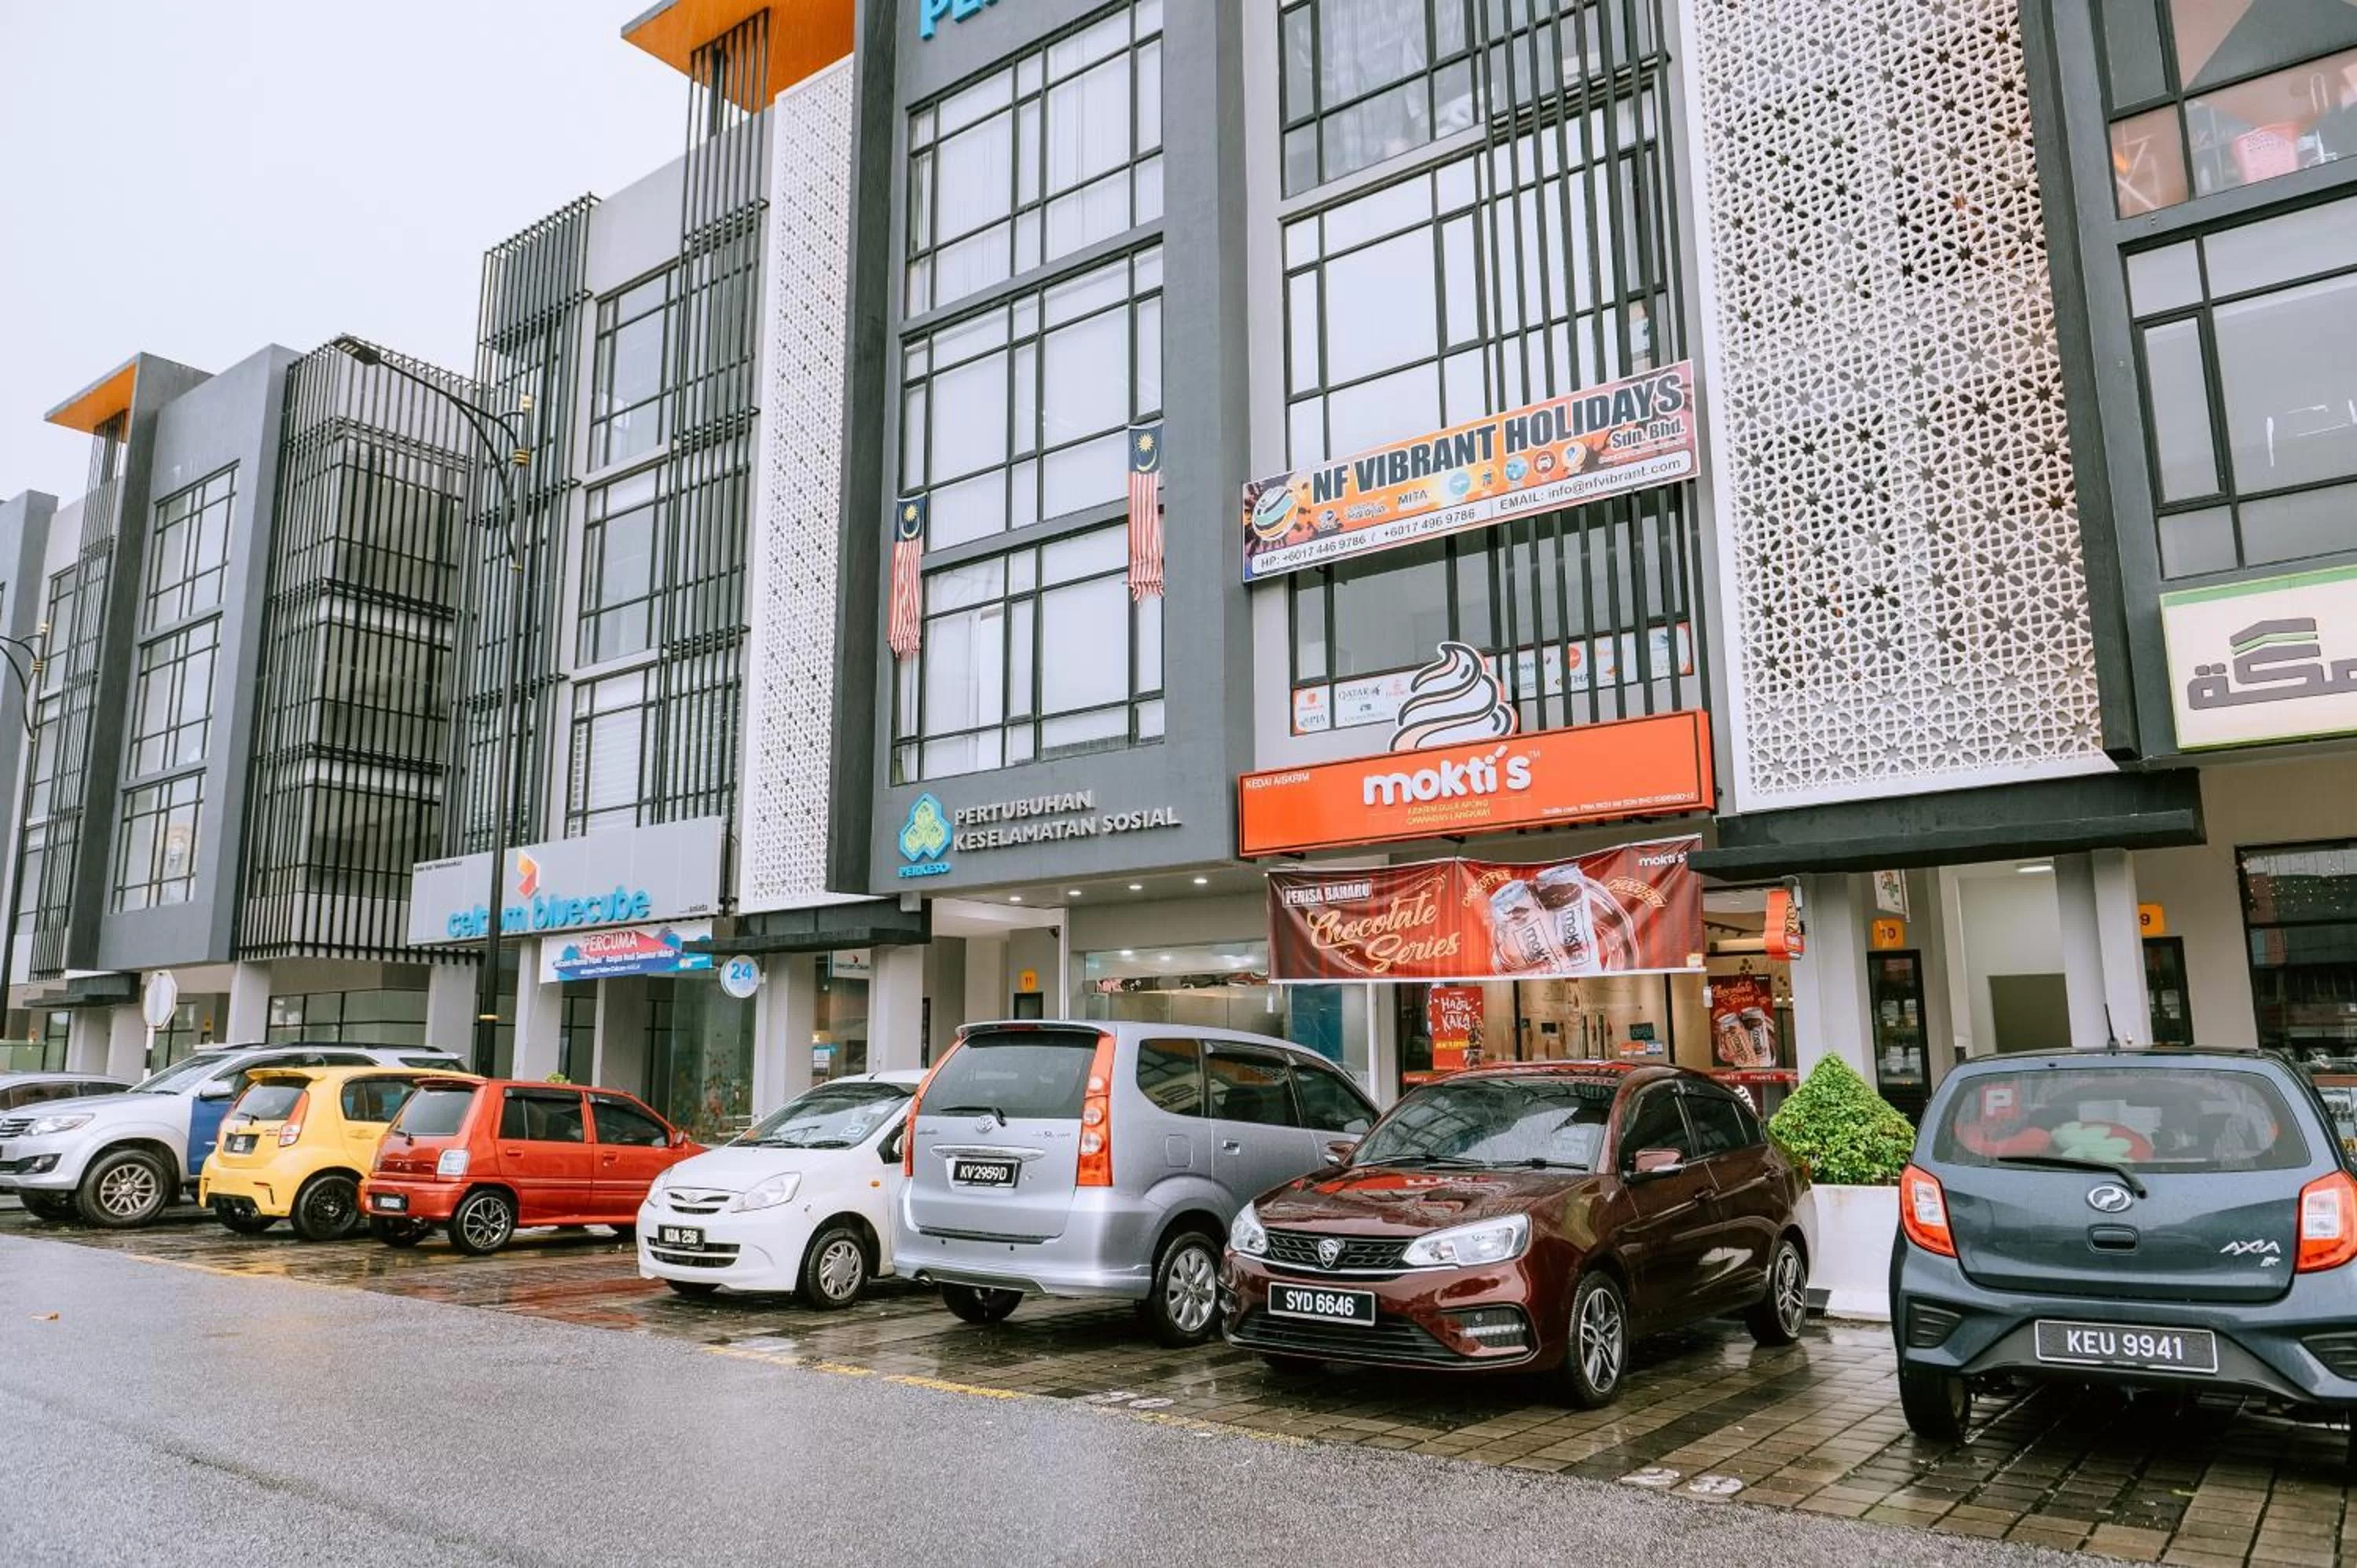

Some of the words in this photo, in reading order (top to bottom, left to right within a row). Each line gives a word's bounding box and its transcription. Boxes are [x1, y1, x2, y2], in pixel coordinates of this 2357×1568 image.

[1311, 465, 1349, 504] NF
[1354, 423, 1497, 493] VIBRANT
[1505, 372, 1684, 454] HOLIDAYS
[1611, 430, 1646, 450] Sdn.
[1649, 417, 1685, 441] Bhd.
[1500, 492, 1544, 510] EMAIL:
[1548, 458, 1681, 500] info@nfvibrant.com
[1260, 554, 1280, 568] HP:
[1282, 547, 1313, 563] +6017
[1316, 540, 1336, 556] 446
[1339, 534, 1366, 551] 9786
[1384, 522, 1417, 538] +6017
[1421, 515, 1443, 530] 496
[1446, 508, 1475, 525] 9786
[1245, 777, 1272, 789] KEDAI
[955, 790, 1094, 826] PERTUBUHAN
[953, 815, 1097, 852] KESELAMATAN
[1102, 806, 1182, 833] SOSIAL
[1285, 888, 1324, 905] PERISA
[1325, 882, 1372, 902] BAHARU
[447, 903, 529, 938] celcm
[532, 885, 653, 930] bluecube
[1307, 891, 1438, 950] Chocolate
[585, 931, 638, 952] PERCUMA
[1365, 932, 1461, 974] Series
[731, 962, 753, 981] 24
[1985, 1088, 2013, 1116] P
[959, 1164, 1009, 1181] KV2959D
[1285, 1290, 1313, 1313] SYD
[1316, 1294, 1354, 1317] 6646
[2067, 1330, 2116, 1357] KEU
[2122, 1332, 2183, 1361] 9941
